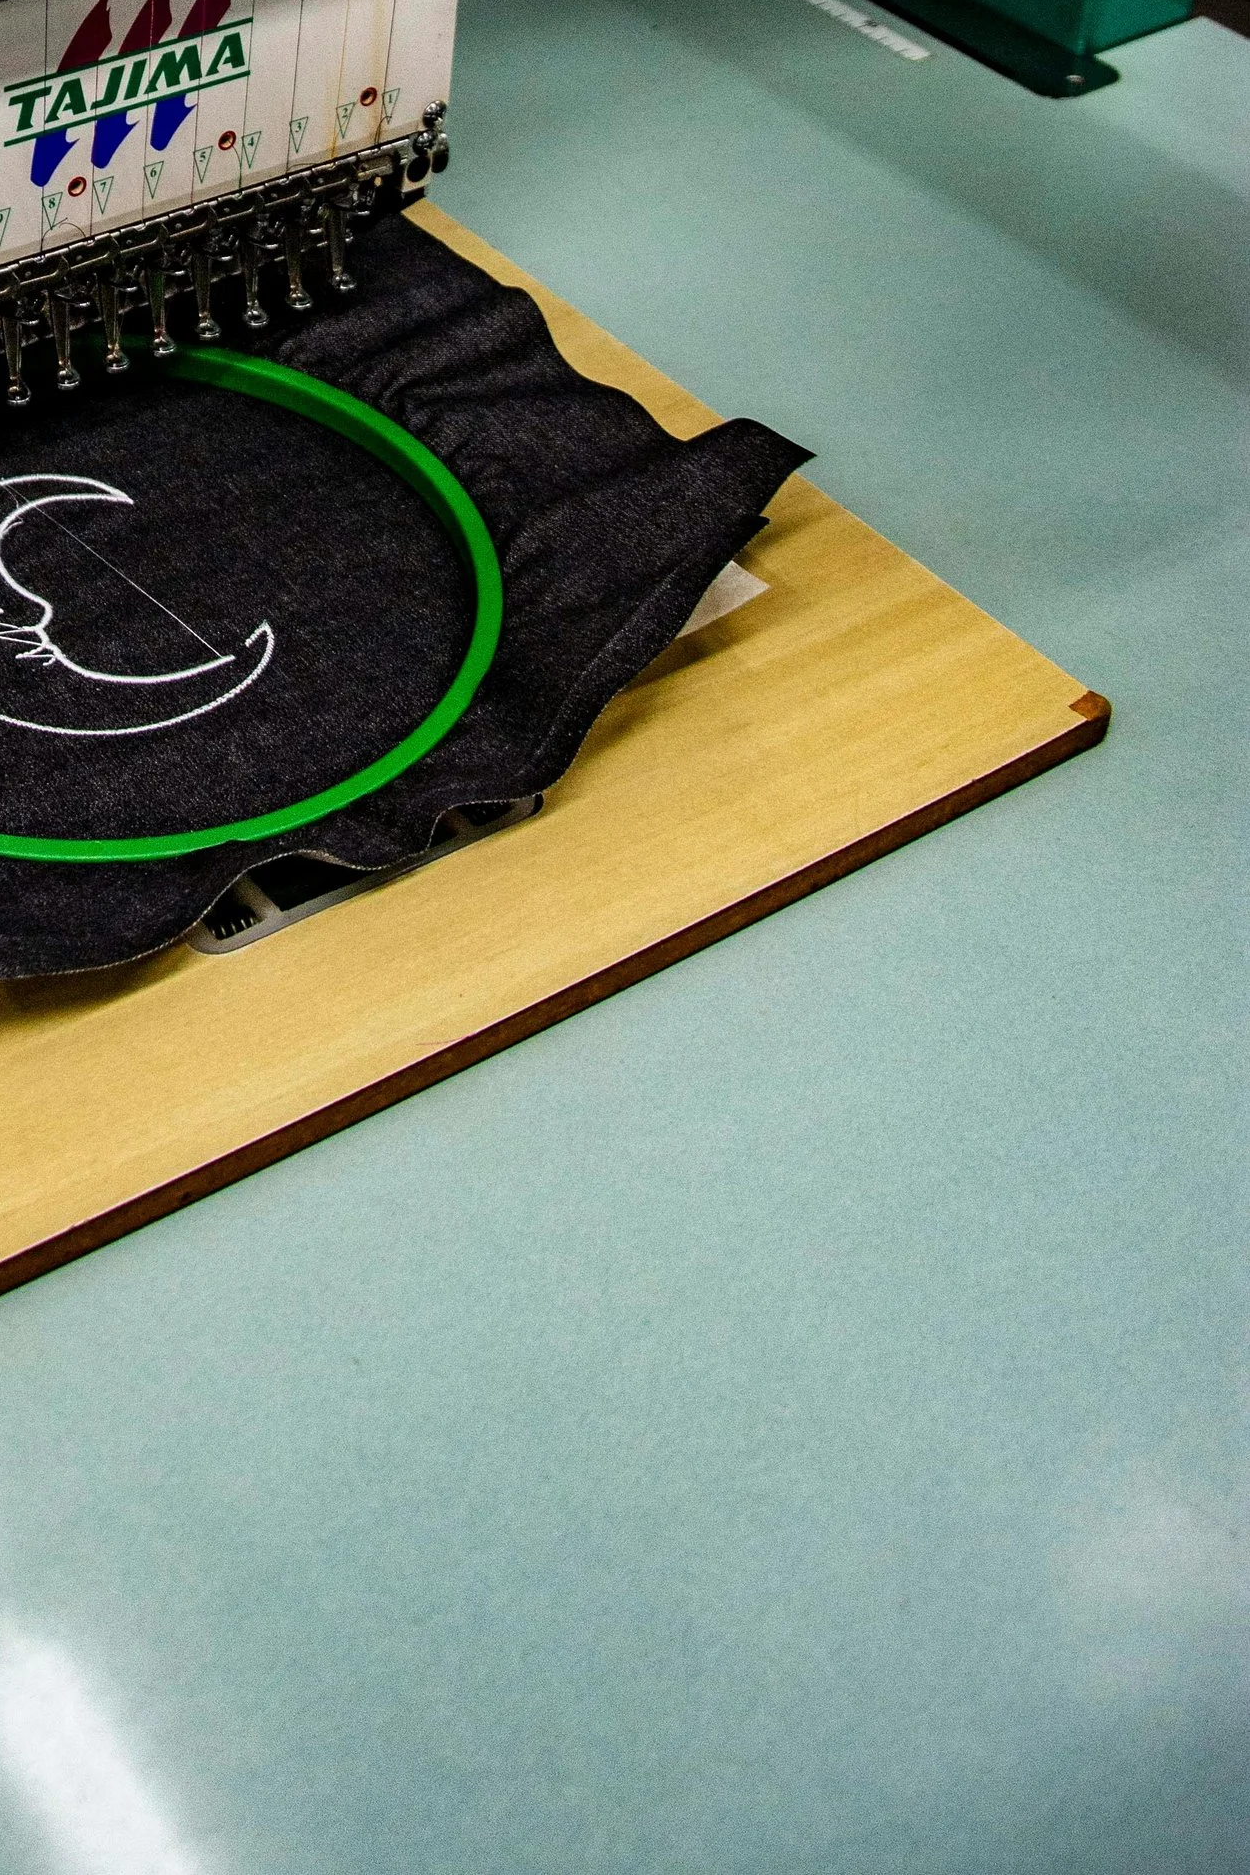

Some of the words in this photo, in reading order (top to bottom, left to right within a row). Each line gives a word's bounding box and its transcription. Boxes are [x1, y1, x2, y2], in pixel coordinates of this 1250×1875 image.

[8, 32, 245, 132] TAJIMA
[388, 93, 393, 104] 1
[342, 107, 350, 118] 2
[295, 121, 302, 132] 3
[248, 136, 254, 147] 4
[199, 151, 206, 162] 5
[150, 167, 157, 178] 6
[100, 181, 107, 193] 7
[48, 198, 56, 209] 8
